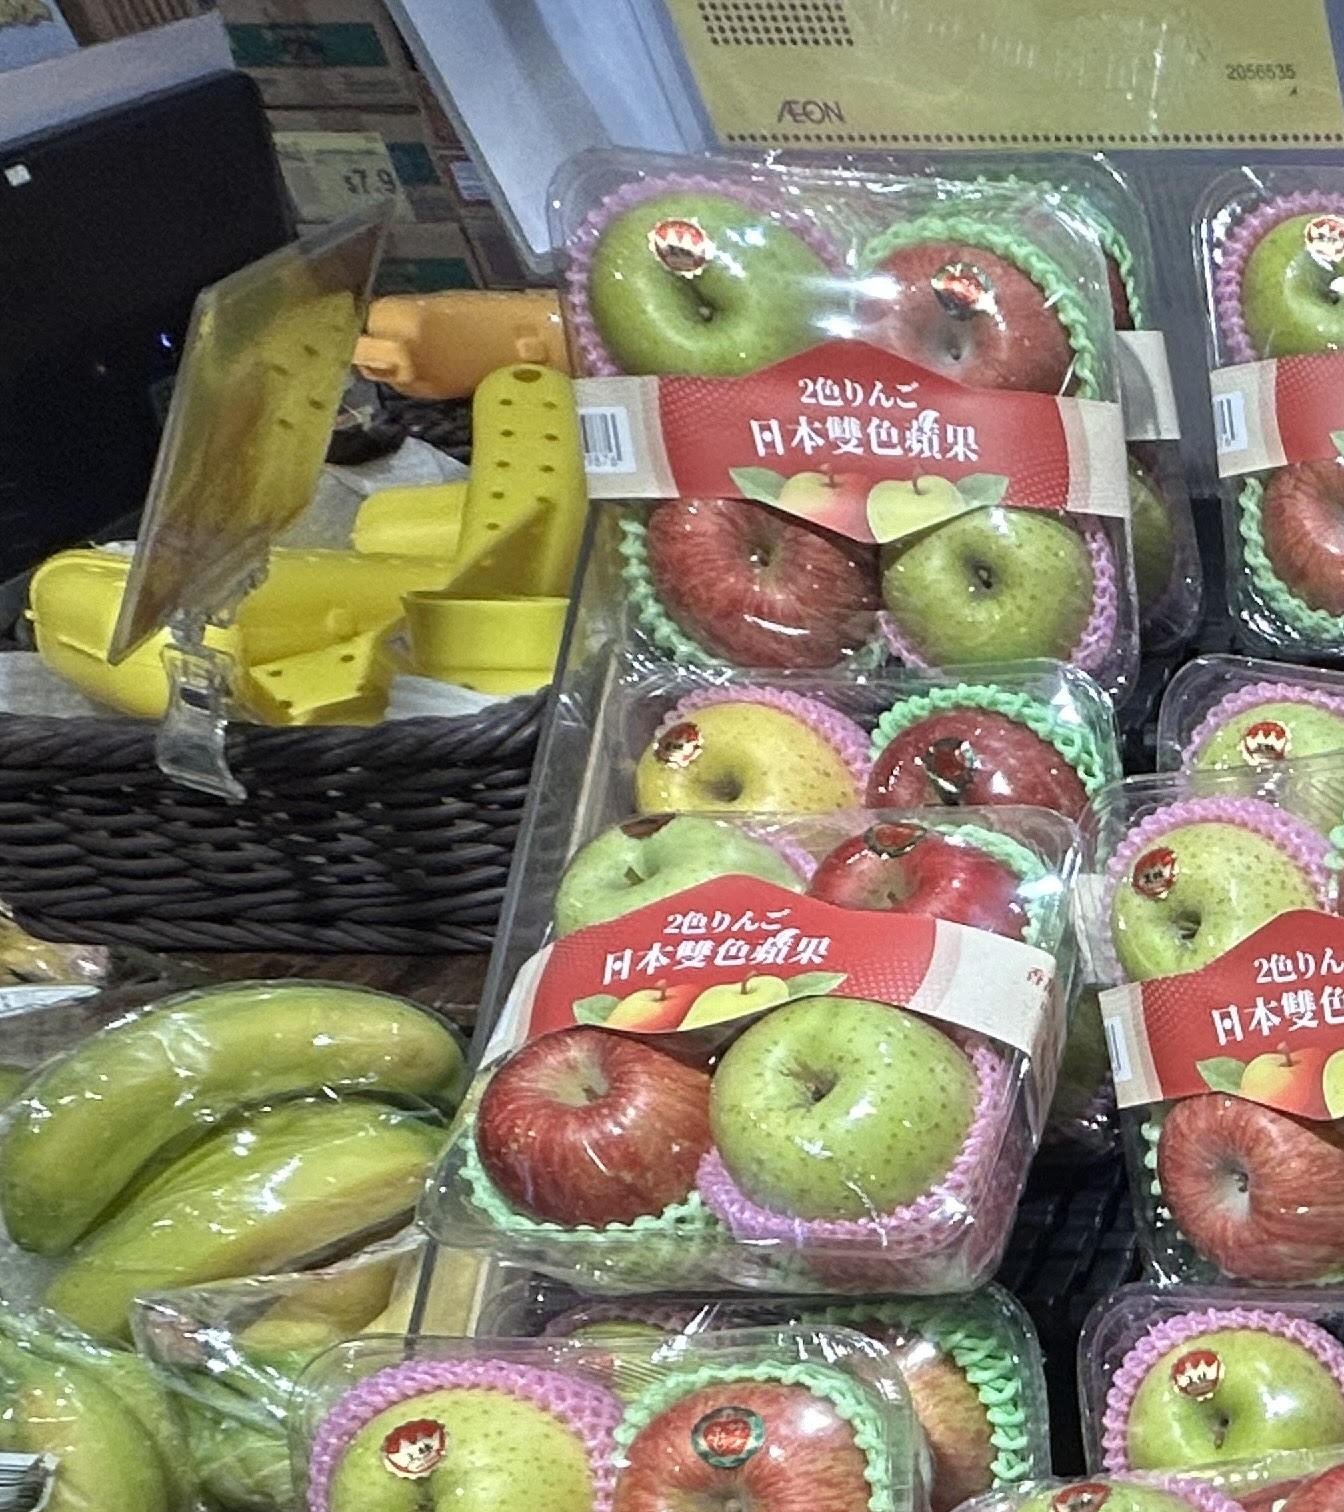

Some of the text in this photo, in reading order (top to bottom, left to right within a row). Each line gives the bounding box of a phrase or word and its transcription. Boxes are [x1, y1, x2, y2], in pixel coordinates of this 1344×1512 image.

[799, 378, 920, 408] 2色りんご
[750, 410, 979, 461] 日本雙色蘋果
[665, 908, 793, 935] 2色りんご
[603, 929, 831, 985] 日本雙色蘋果
